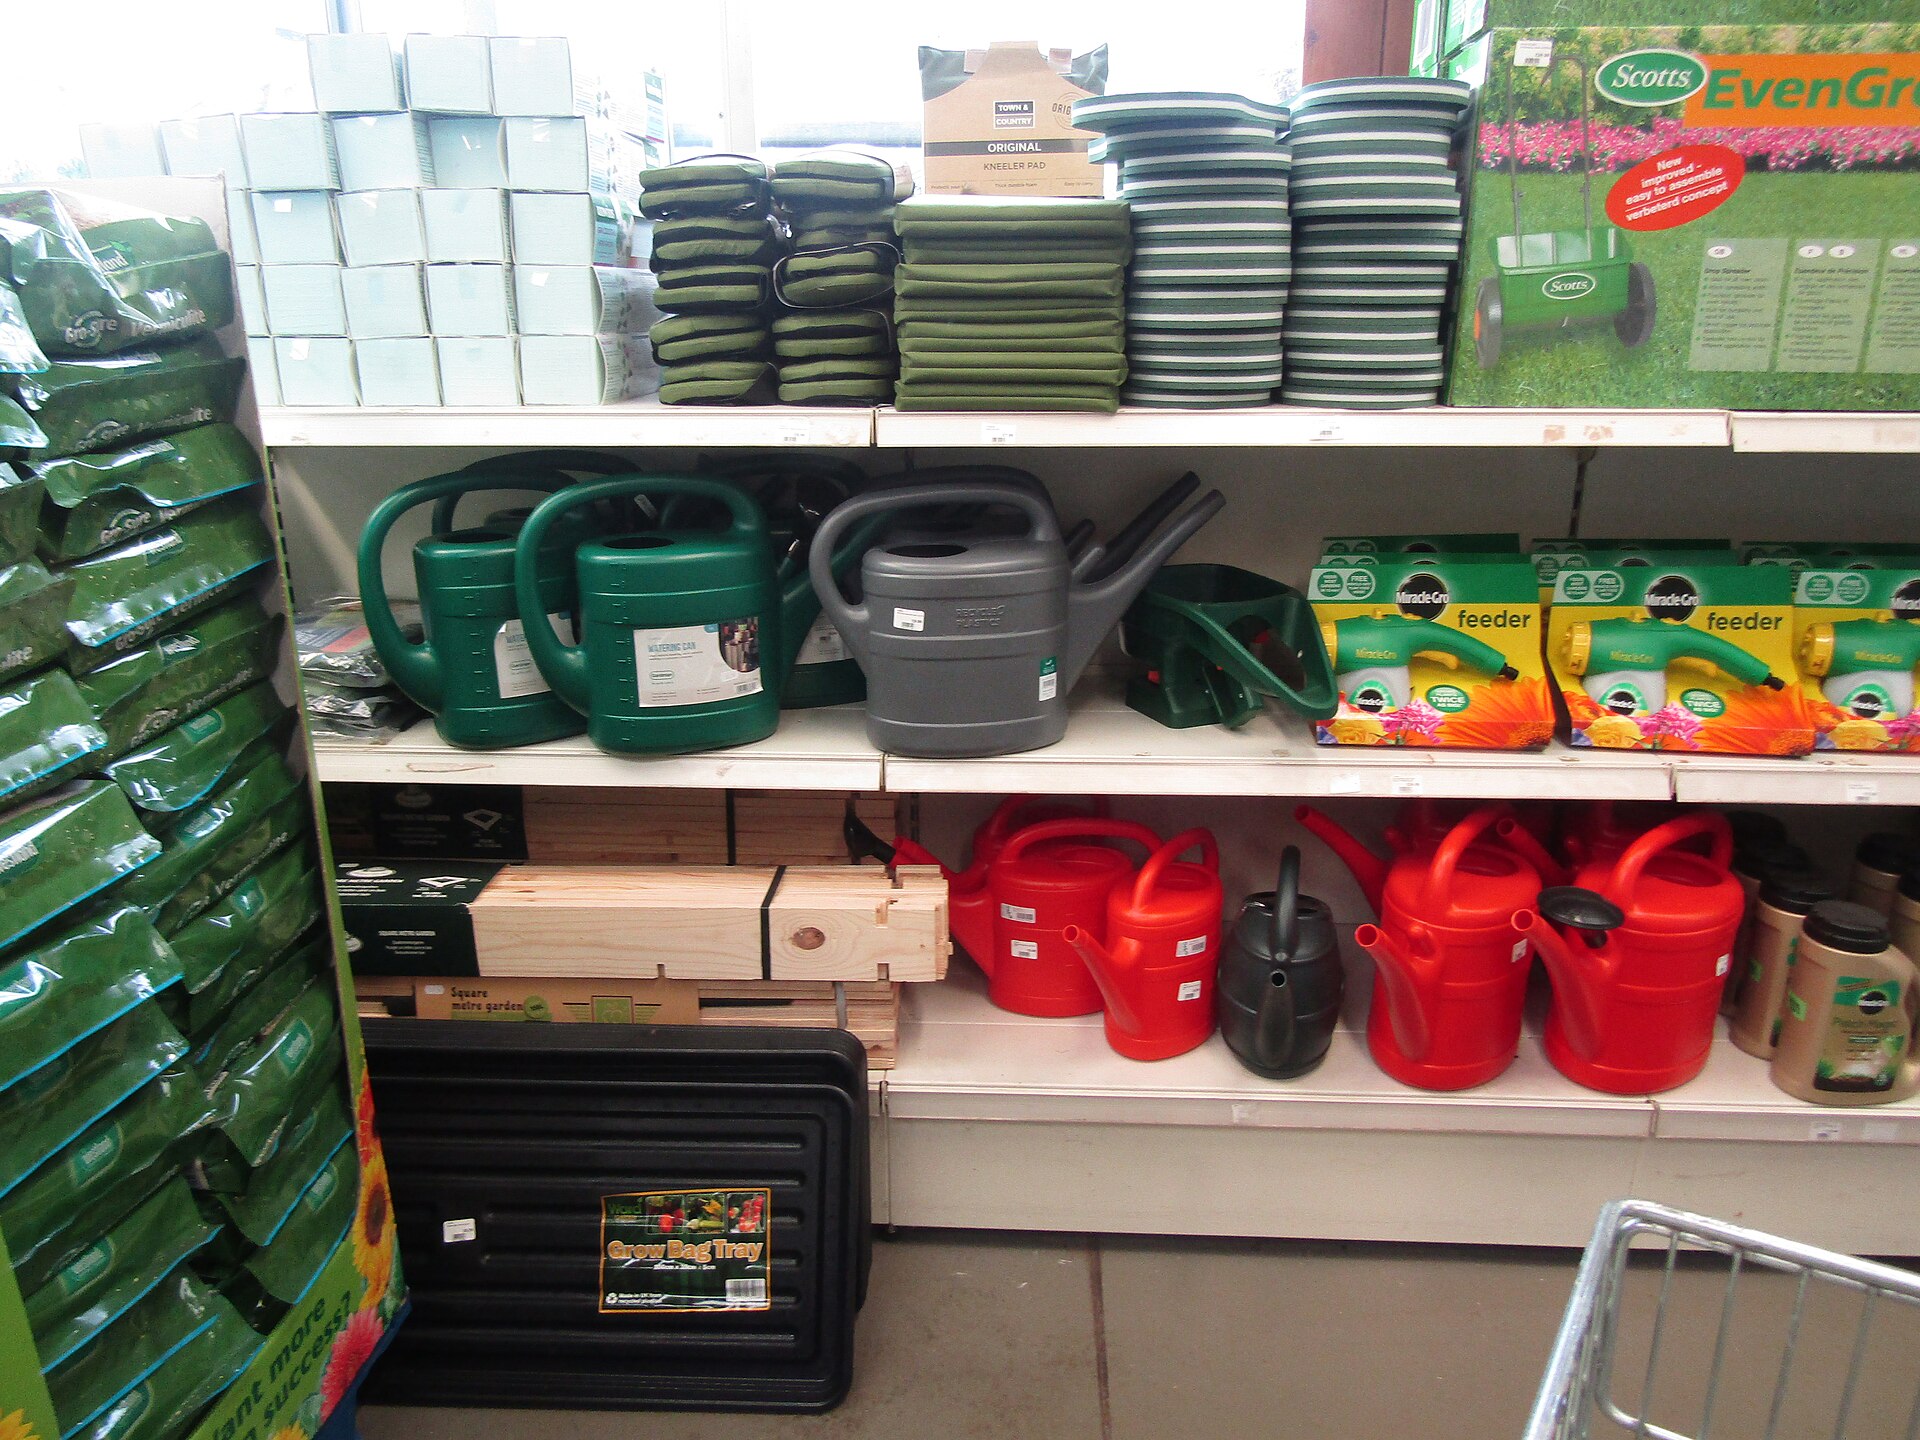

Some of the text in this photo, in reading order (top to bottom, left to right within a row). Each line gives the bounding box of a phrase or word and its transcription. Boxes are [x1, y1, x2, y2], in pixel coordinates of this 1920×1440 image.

[1610, 64, 1691, 90] Scotts
[998, 104, 1029, 113] TOWN &
[995, 116, 1033, 126] COUNTRY
[987, 142, 1042, 153] ORIGINAL
[983, 161, 1046, 171] KNEELER PAD
[1656, 156, 1683, 172] New
[1641, 163, 1695, 189] improved
[1625, 166, 1724, 206] easy to assemble
[1625, 181, 1729, 222] verbeterd concept
[1549, 277, 1591, 294] Scotts
[1395, 591, 1449, 604] Miracle-Gro
[1458, 609, 1531, 628] feeder
[1707, 611, 1784, 631] feeder
[647, 641, 697, 653] WATERING CAN
[1431, 696, 1466, 704] TWICE
[451, 986, 489, 1001] Square
[452, 1001, 482, 1011] metre
[486, 1000, 524, 1013] garden
[607, 1238, 764, 1263] Grow Bag Tray
[270, 1298, 325, 1384] more
